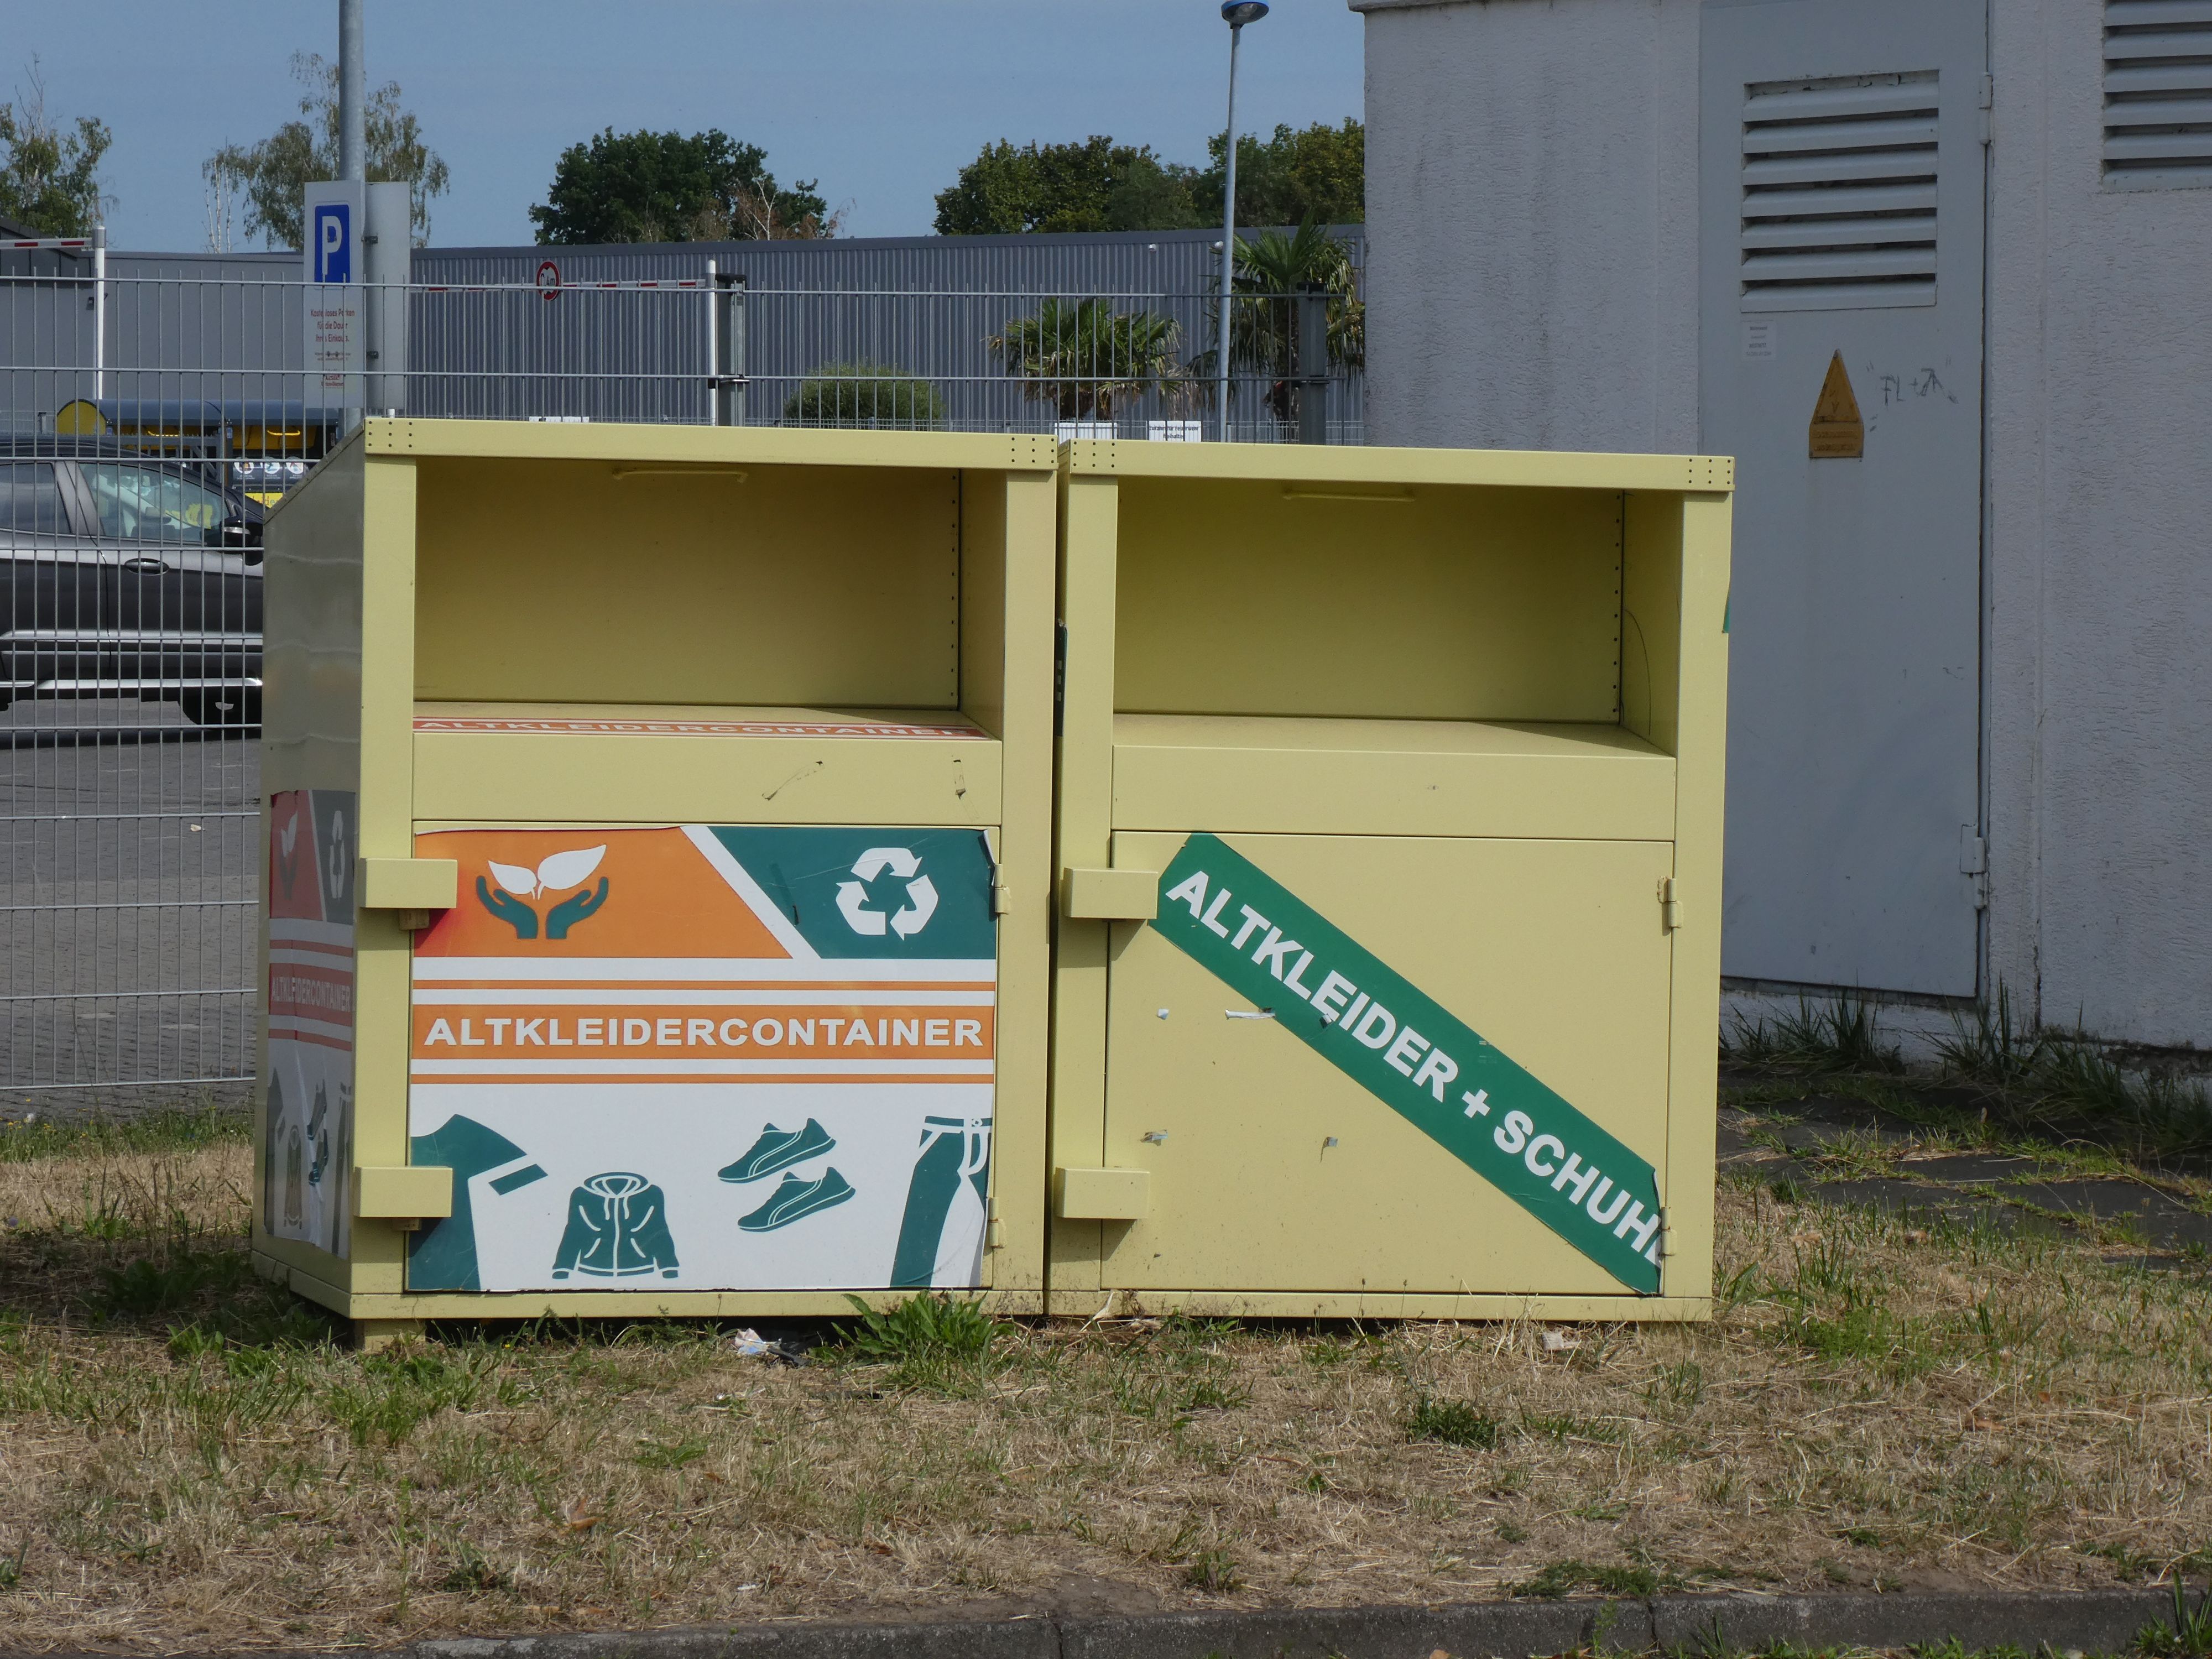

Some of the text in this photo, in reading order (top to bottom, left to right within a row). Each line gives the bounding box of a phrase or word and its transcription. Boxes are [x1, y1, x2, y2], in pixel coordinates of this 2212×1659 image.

[322, 216, 342, 275] P
[420, 722, 969, 735] ALTKLEIDERCONTAINER
[1165, 870, 1458, 1103] ALTKLEIDER
[1462, 1088, 1490, 1118] +
[424, 1018, 983, 1047] ALTKLEIDERCONTAINER
